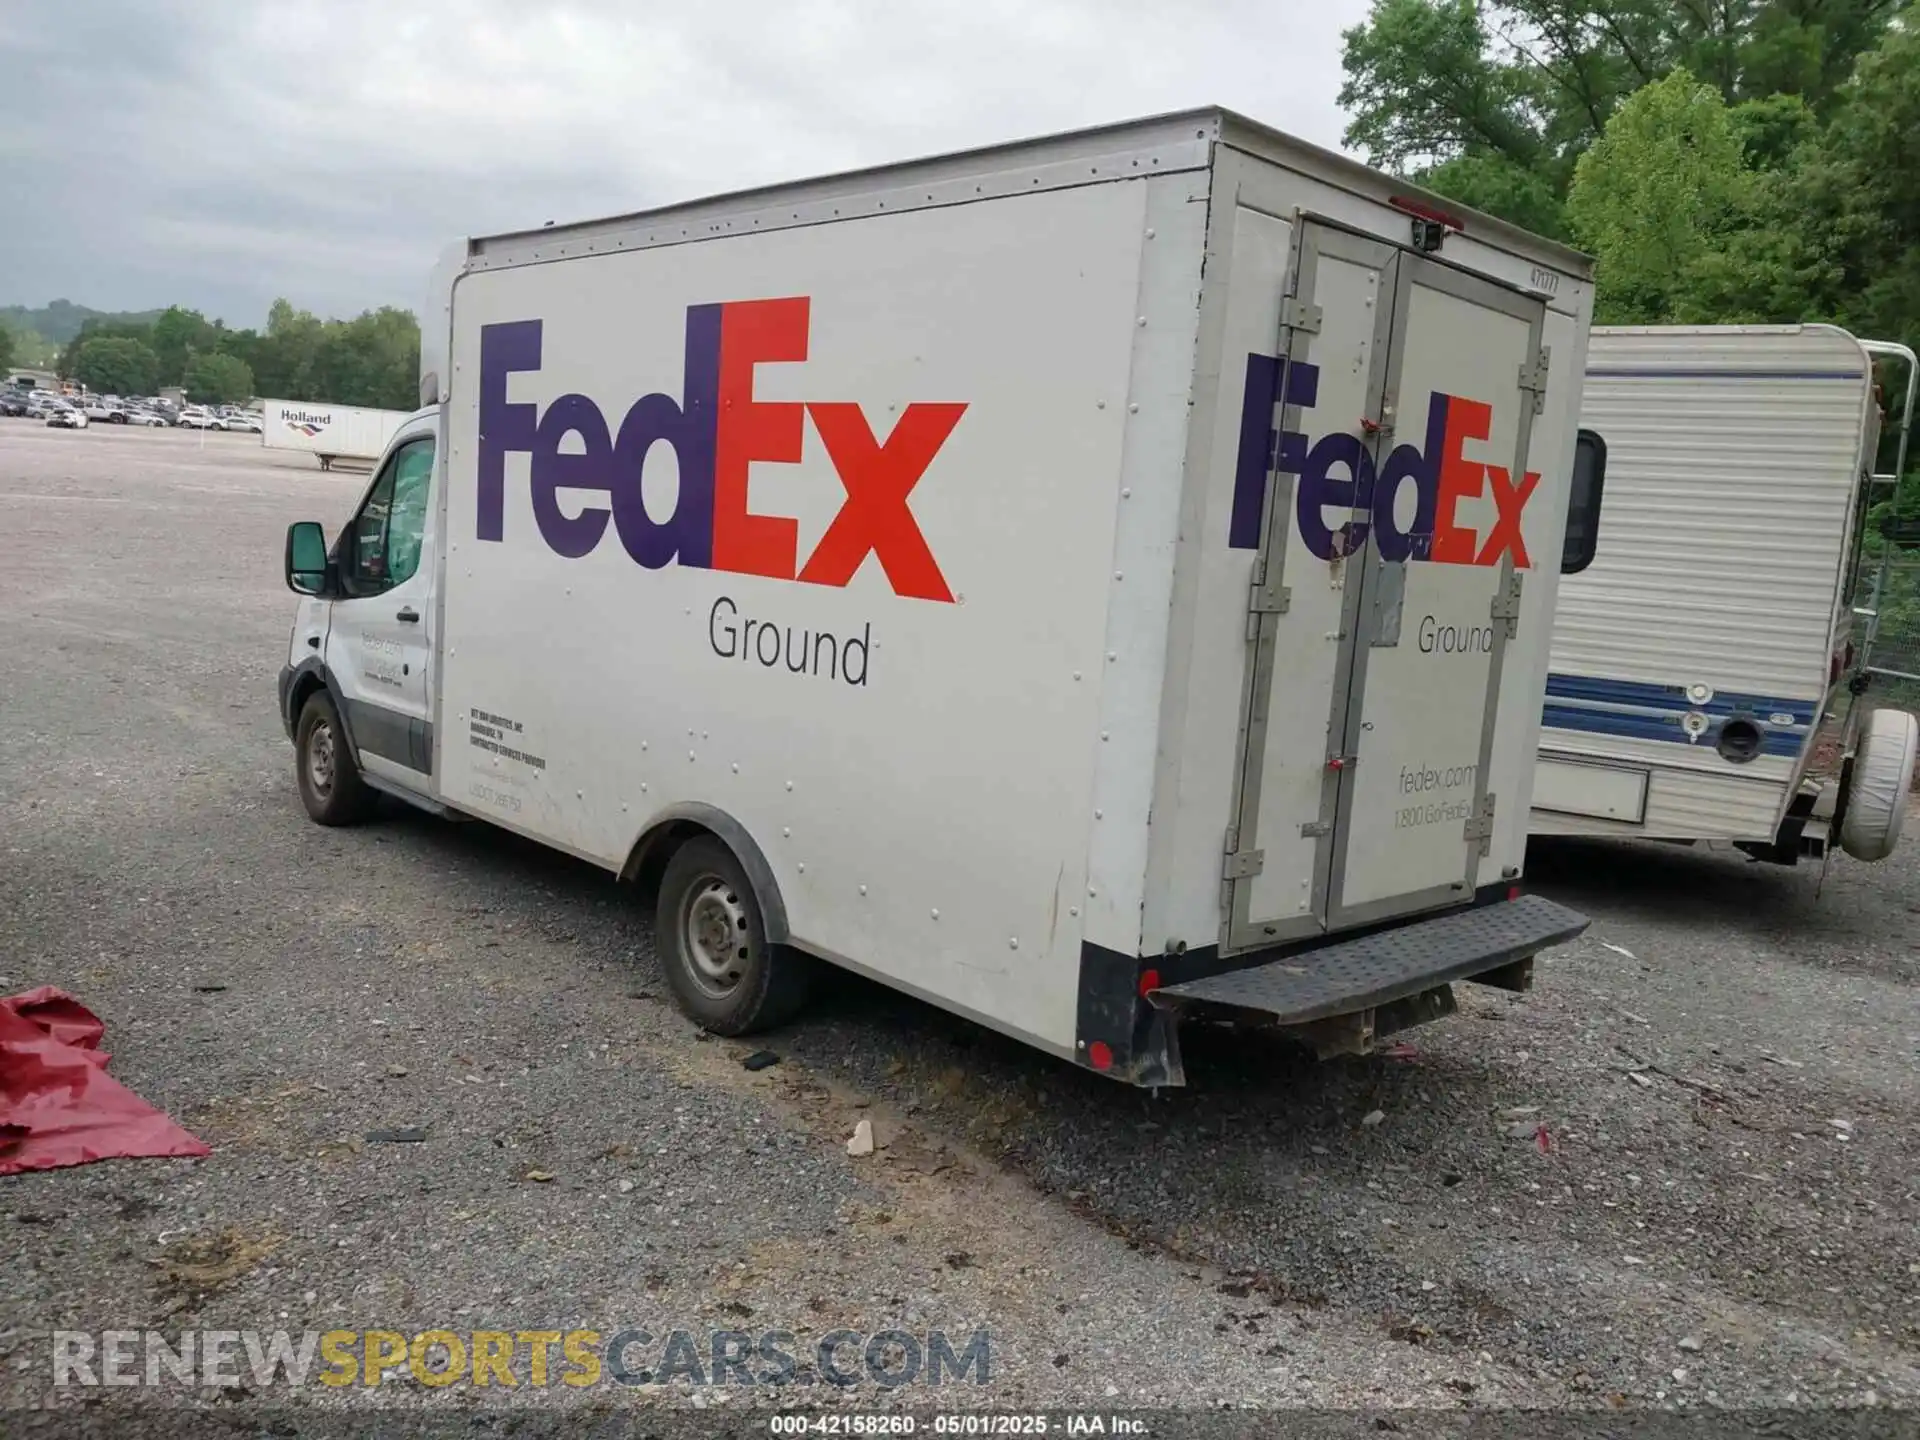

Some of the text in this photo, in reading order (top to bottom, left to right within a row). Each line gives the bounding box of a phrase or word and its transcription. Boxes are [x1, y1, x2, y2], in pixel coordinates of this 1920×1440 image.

[281, 408, 331, 424] Holland
[477, 296, 969, 603] FedEx
[1229, 352, 1541, 568] FedEx
[709, 596, 870, 686] Ground
